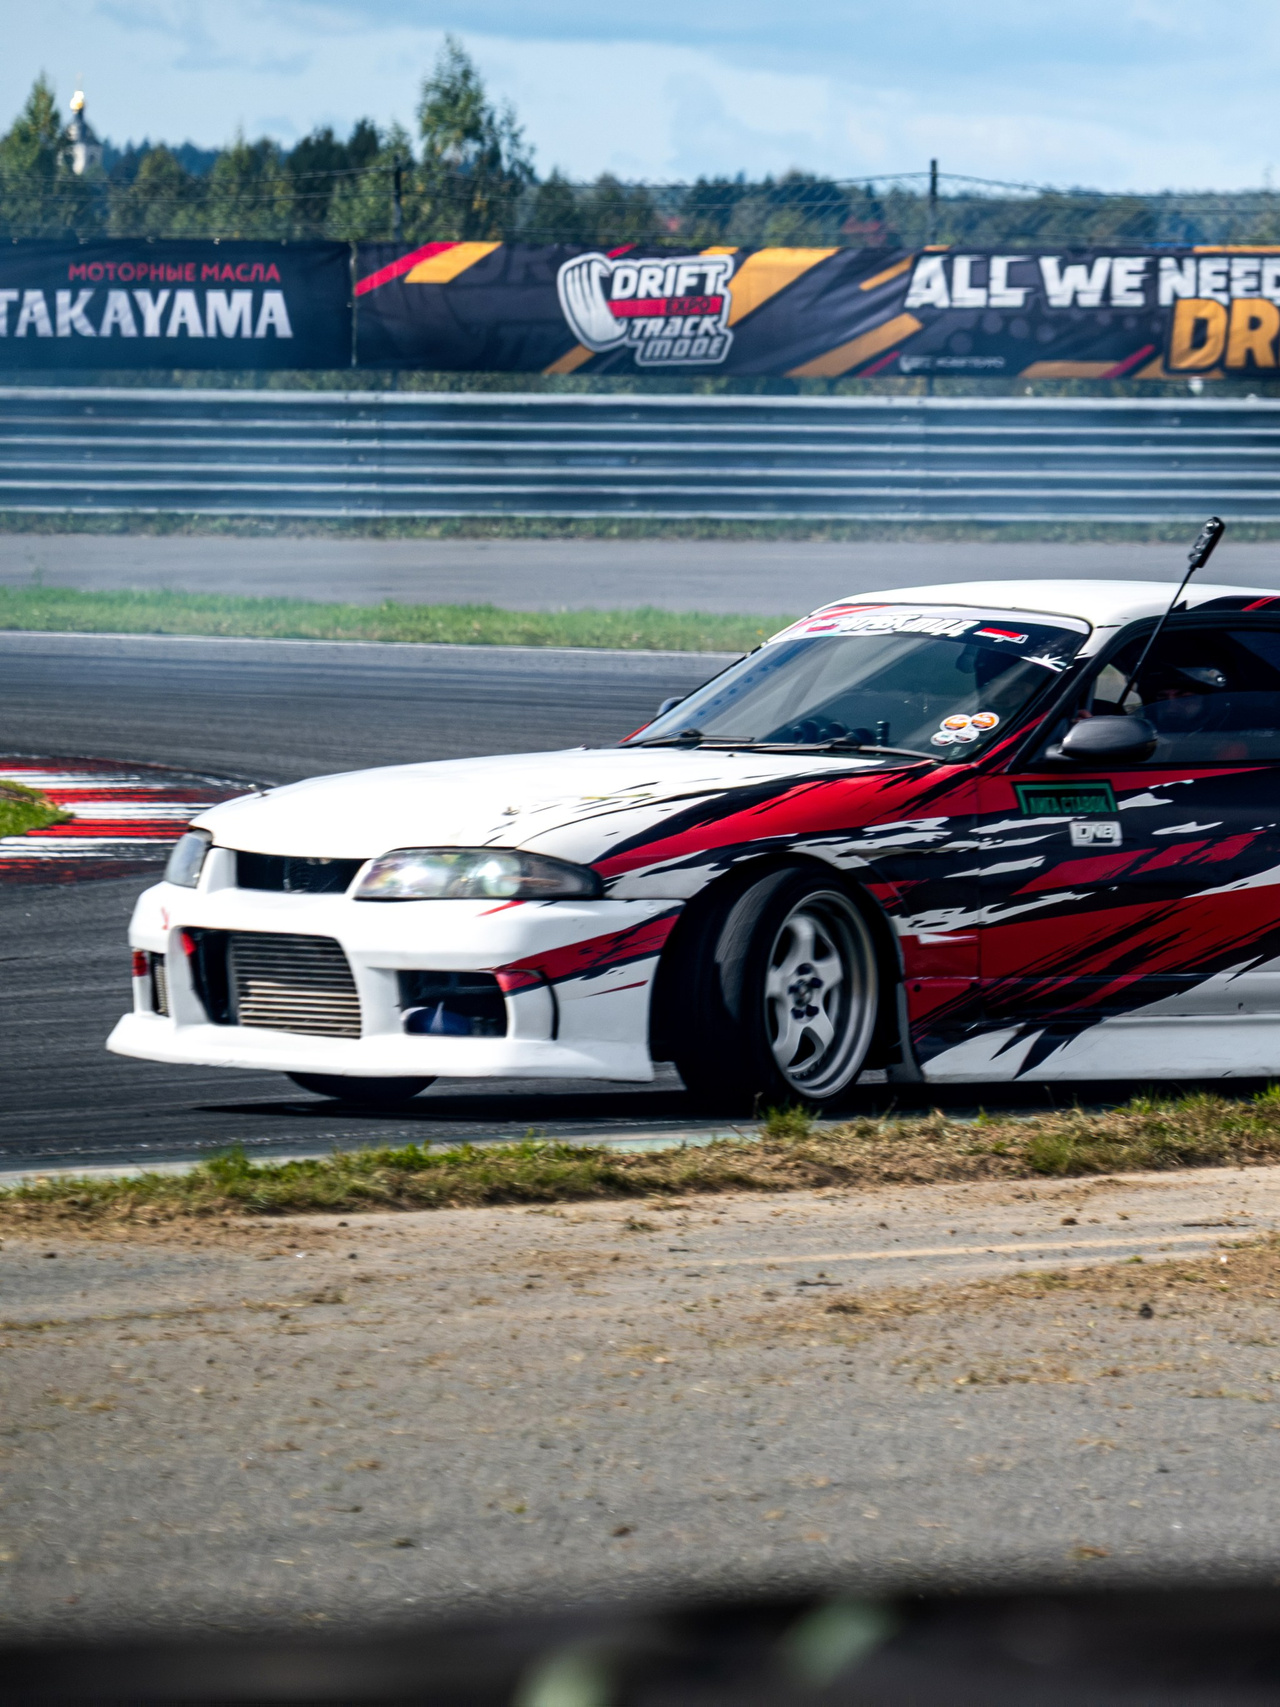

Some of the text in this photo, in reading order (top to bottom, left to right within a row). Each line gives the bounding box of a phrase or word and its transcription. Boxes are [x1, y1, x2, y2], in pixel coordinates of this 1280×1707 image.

[68, 262, 281, 282] МОТОРНЫЕ МАСЛА
[611, 264, 726, 300] DRIFT
[903, 254, 1032, 308] ALL
[1038, 255, 1150, 307] WE
